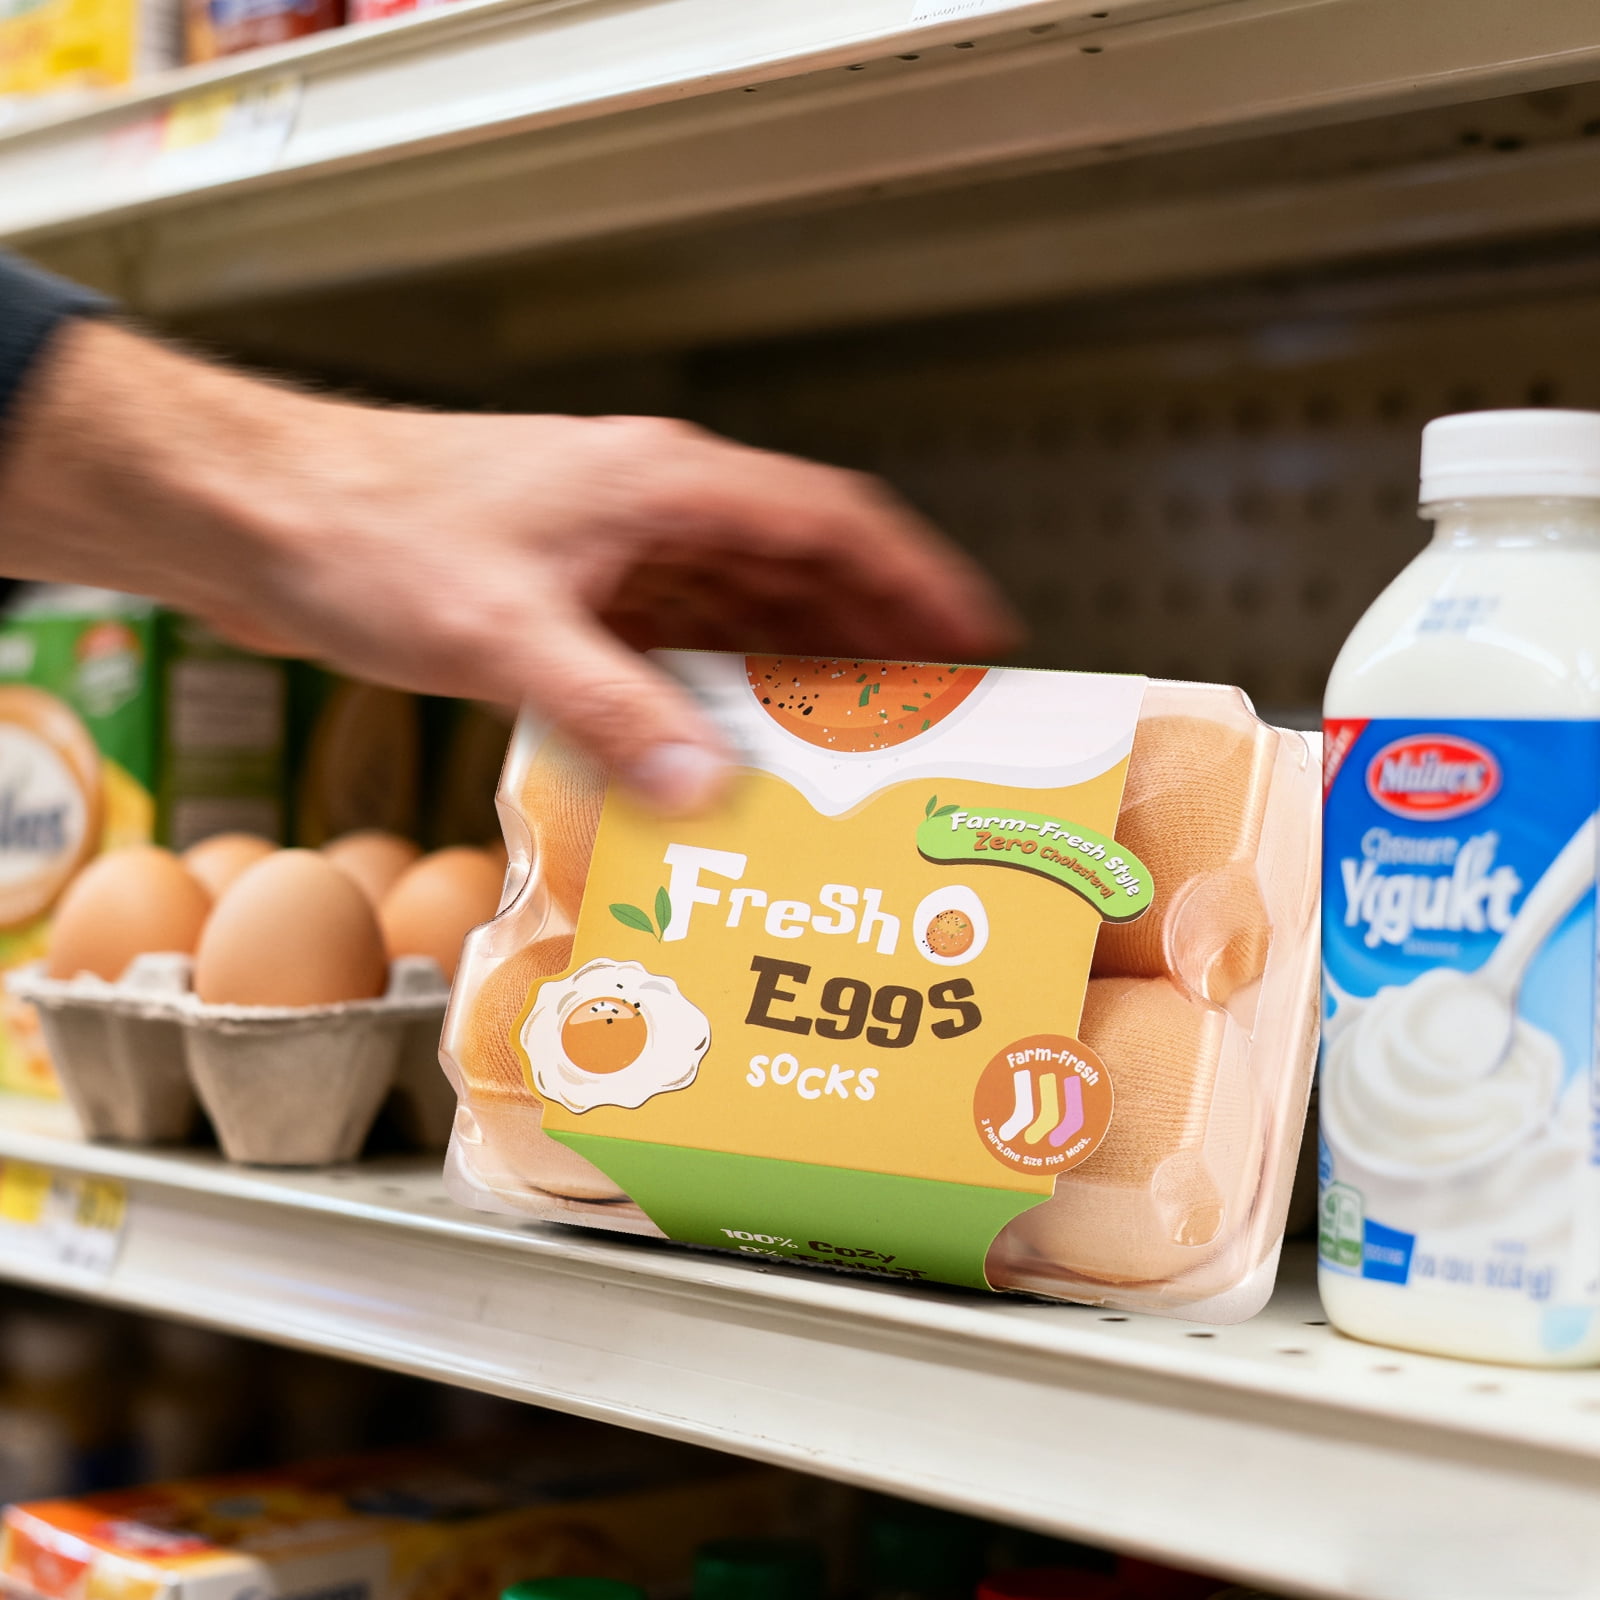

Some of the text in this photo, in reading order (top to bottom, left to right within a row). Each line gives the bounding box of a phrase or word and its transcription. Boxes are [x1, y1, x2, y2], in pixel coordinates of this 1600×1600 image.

[950, 812, 1141, 897] Farm-Fresh Style
[974, 831, 1115, 898] Zero Cholesterol
[663, 843, 900, 955] Fresh
[745, 955, 982, 1049] Eggs
[1022, 1155, 1042, 1167] Size
[1045, 1153, 1065, 1166] Fits
[1065, 1136, 1092, 1159] Most.
[720, 1228, 896, 1264] 100% Cozy
